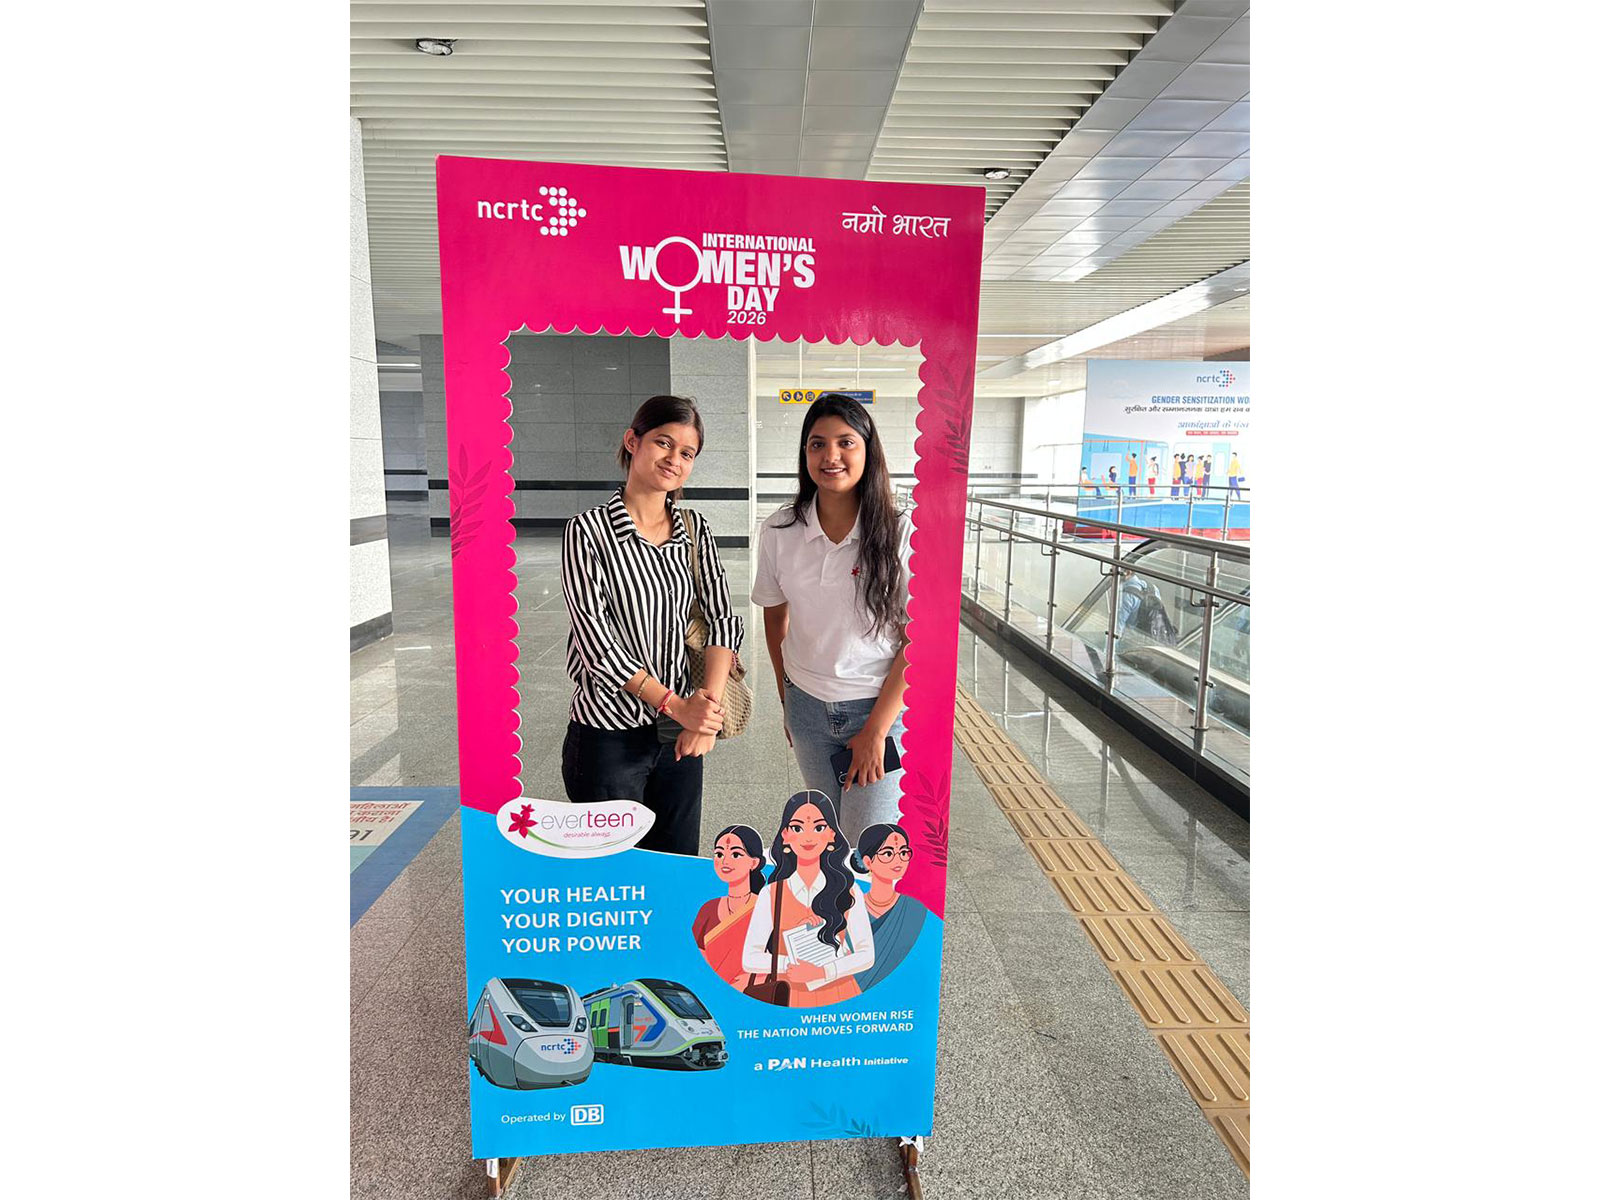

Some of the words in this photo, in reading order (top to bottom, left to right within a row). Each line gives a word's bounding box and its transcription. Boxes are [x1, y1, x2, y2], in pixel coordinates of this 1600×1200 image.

[478, 199, 543, 221] ncrtc
[842, 205, 887, 234] नमो
[892, 214, 952, 238] भारत
[702, 232, 816, 252] INTERNATIONAL
[619, 236, 816, 292] WOMEN'S
[727, 285, 780, 312] DAY
[727, 311, 767, 325] 2026
[1196, 374, 1220, 383] ncrtc
[1151, 395, 1180, 404] GENDER
[1182, 395, 1235, 404] SENSITIZATION
[541, 810, 634, 830] everteen
[563, 831, 590, 839] desirable
[500, 888, 560, 905] YOUR
[567, 885, 645, 902] HEALTH
[501, 912, 561, 929] YOUR
[567, 909, 653, 927] DIGNITY
[501, 937, 561, 954] YOUR
[567, 934, 642, 952] POWER
[800, 1013, 837, 1024] WHEN
[839, 1011, 887, 1022] WOMEN
[890, 1010, 914, 1020] RISE
[737, 1029, 760, 1039] THE
[762, 1026, 808, 1038] NATION
[811, 1024, 853, 1036] MOVES
[856, 1022, 914, 1034] FORWARD
[541, 1043, 565, 1051] ncrtc
[754, 1062, 763, 1071] a
[768, 1057, 806, 1072] PAN
[811, 1056, 861, 1068] Health
[864, 1056, 909, 1066] Initiative
[501, 1112, 551, 1125] Operated
[553, 1112, 566, 1124] by
[573, 1107, 601, 1123] DB
